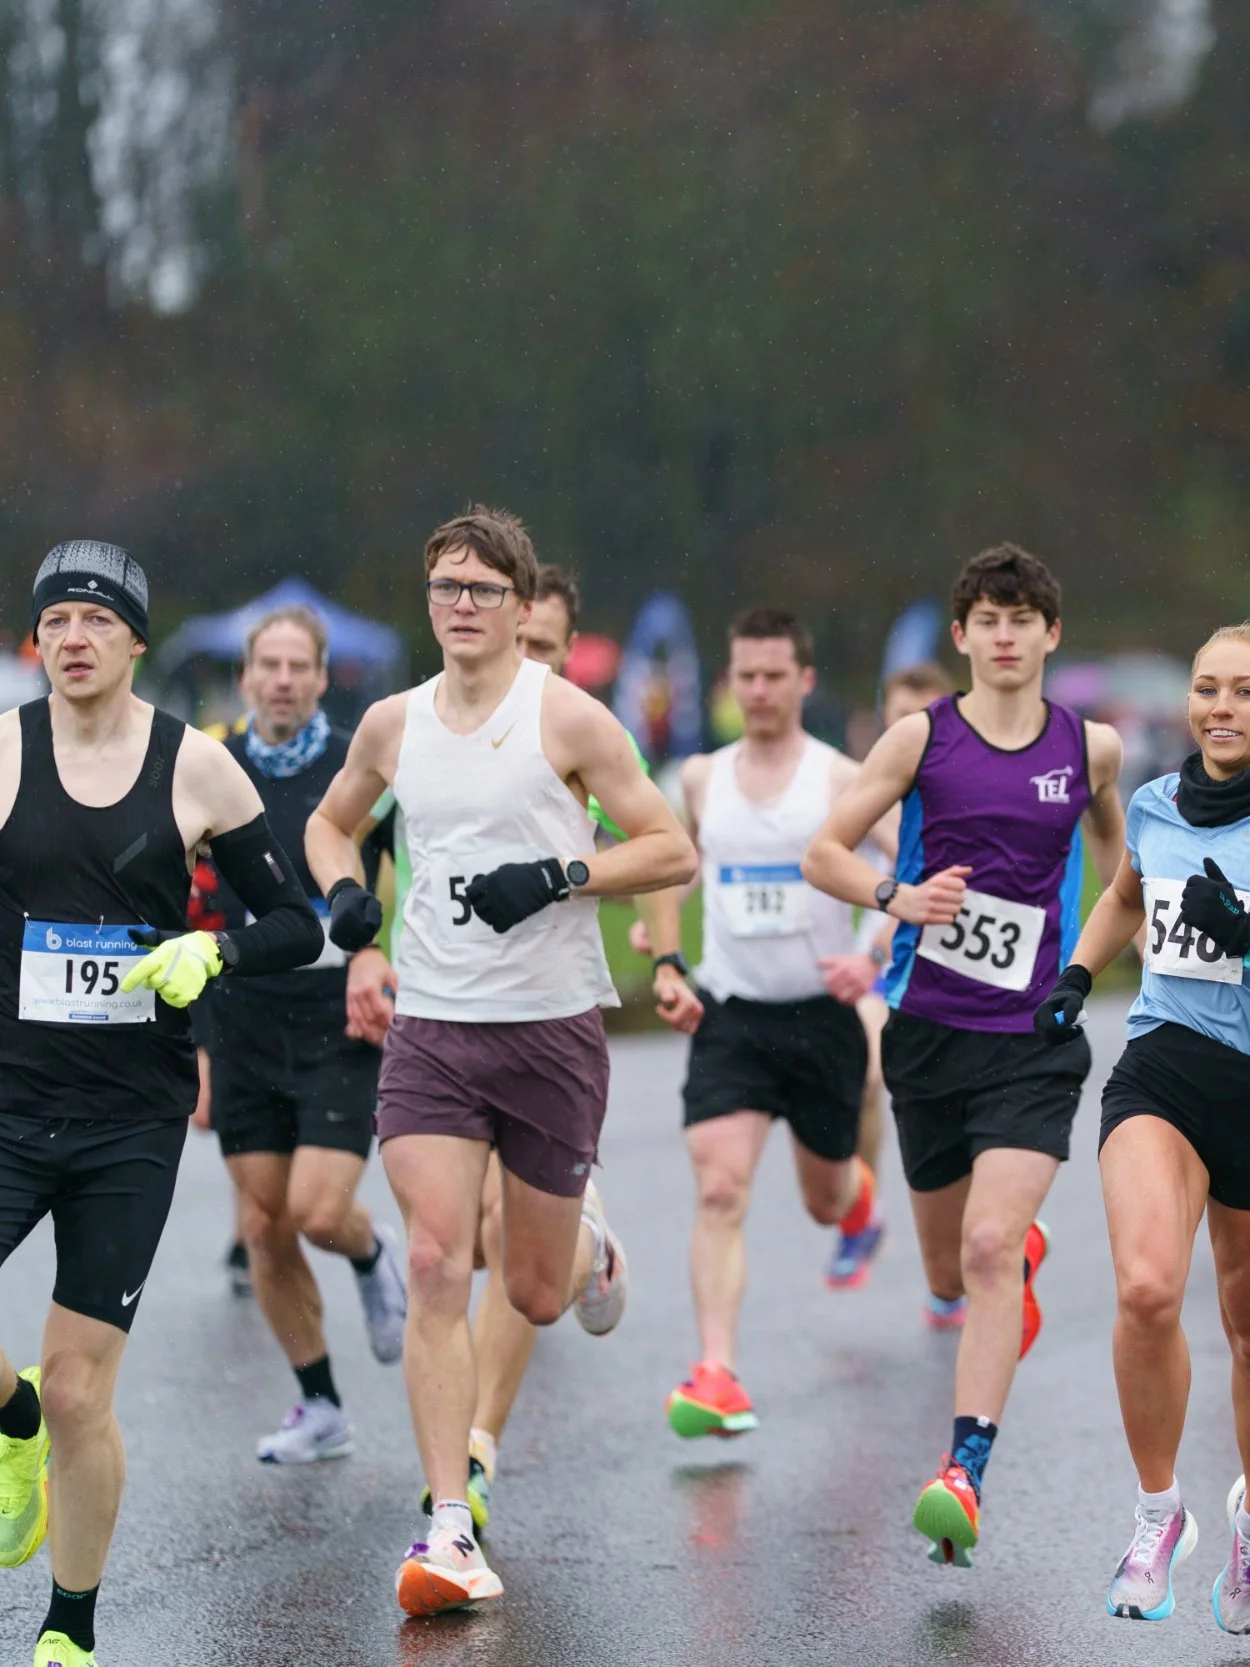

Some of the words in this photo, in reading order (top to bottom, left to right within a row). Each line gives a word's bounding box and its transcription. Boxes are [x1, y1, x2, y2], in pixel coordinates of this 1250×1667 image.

[66, 937, 93, 949] blast
[95, 940, 138, 951] running
[940, 907, 1021, 969] 553
[65, 959, 119, 996] 195
[33, 997, 143, 1010] www.blastrunning.co.uk
